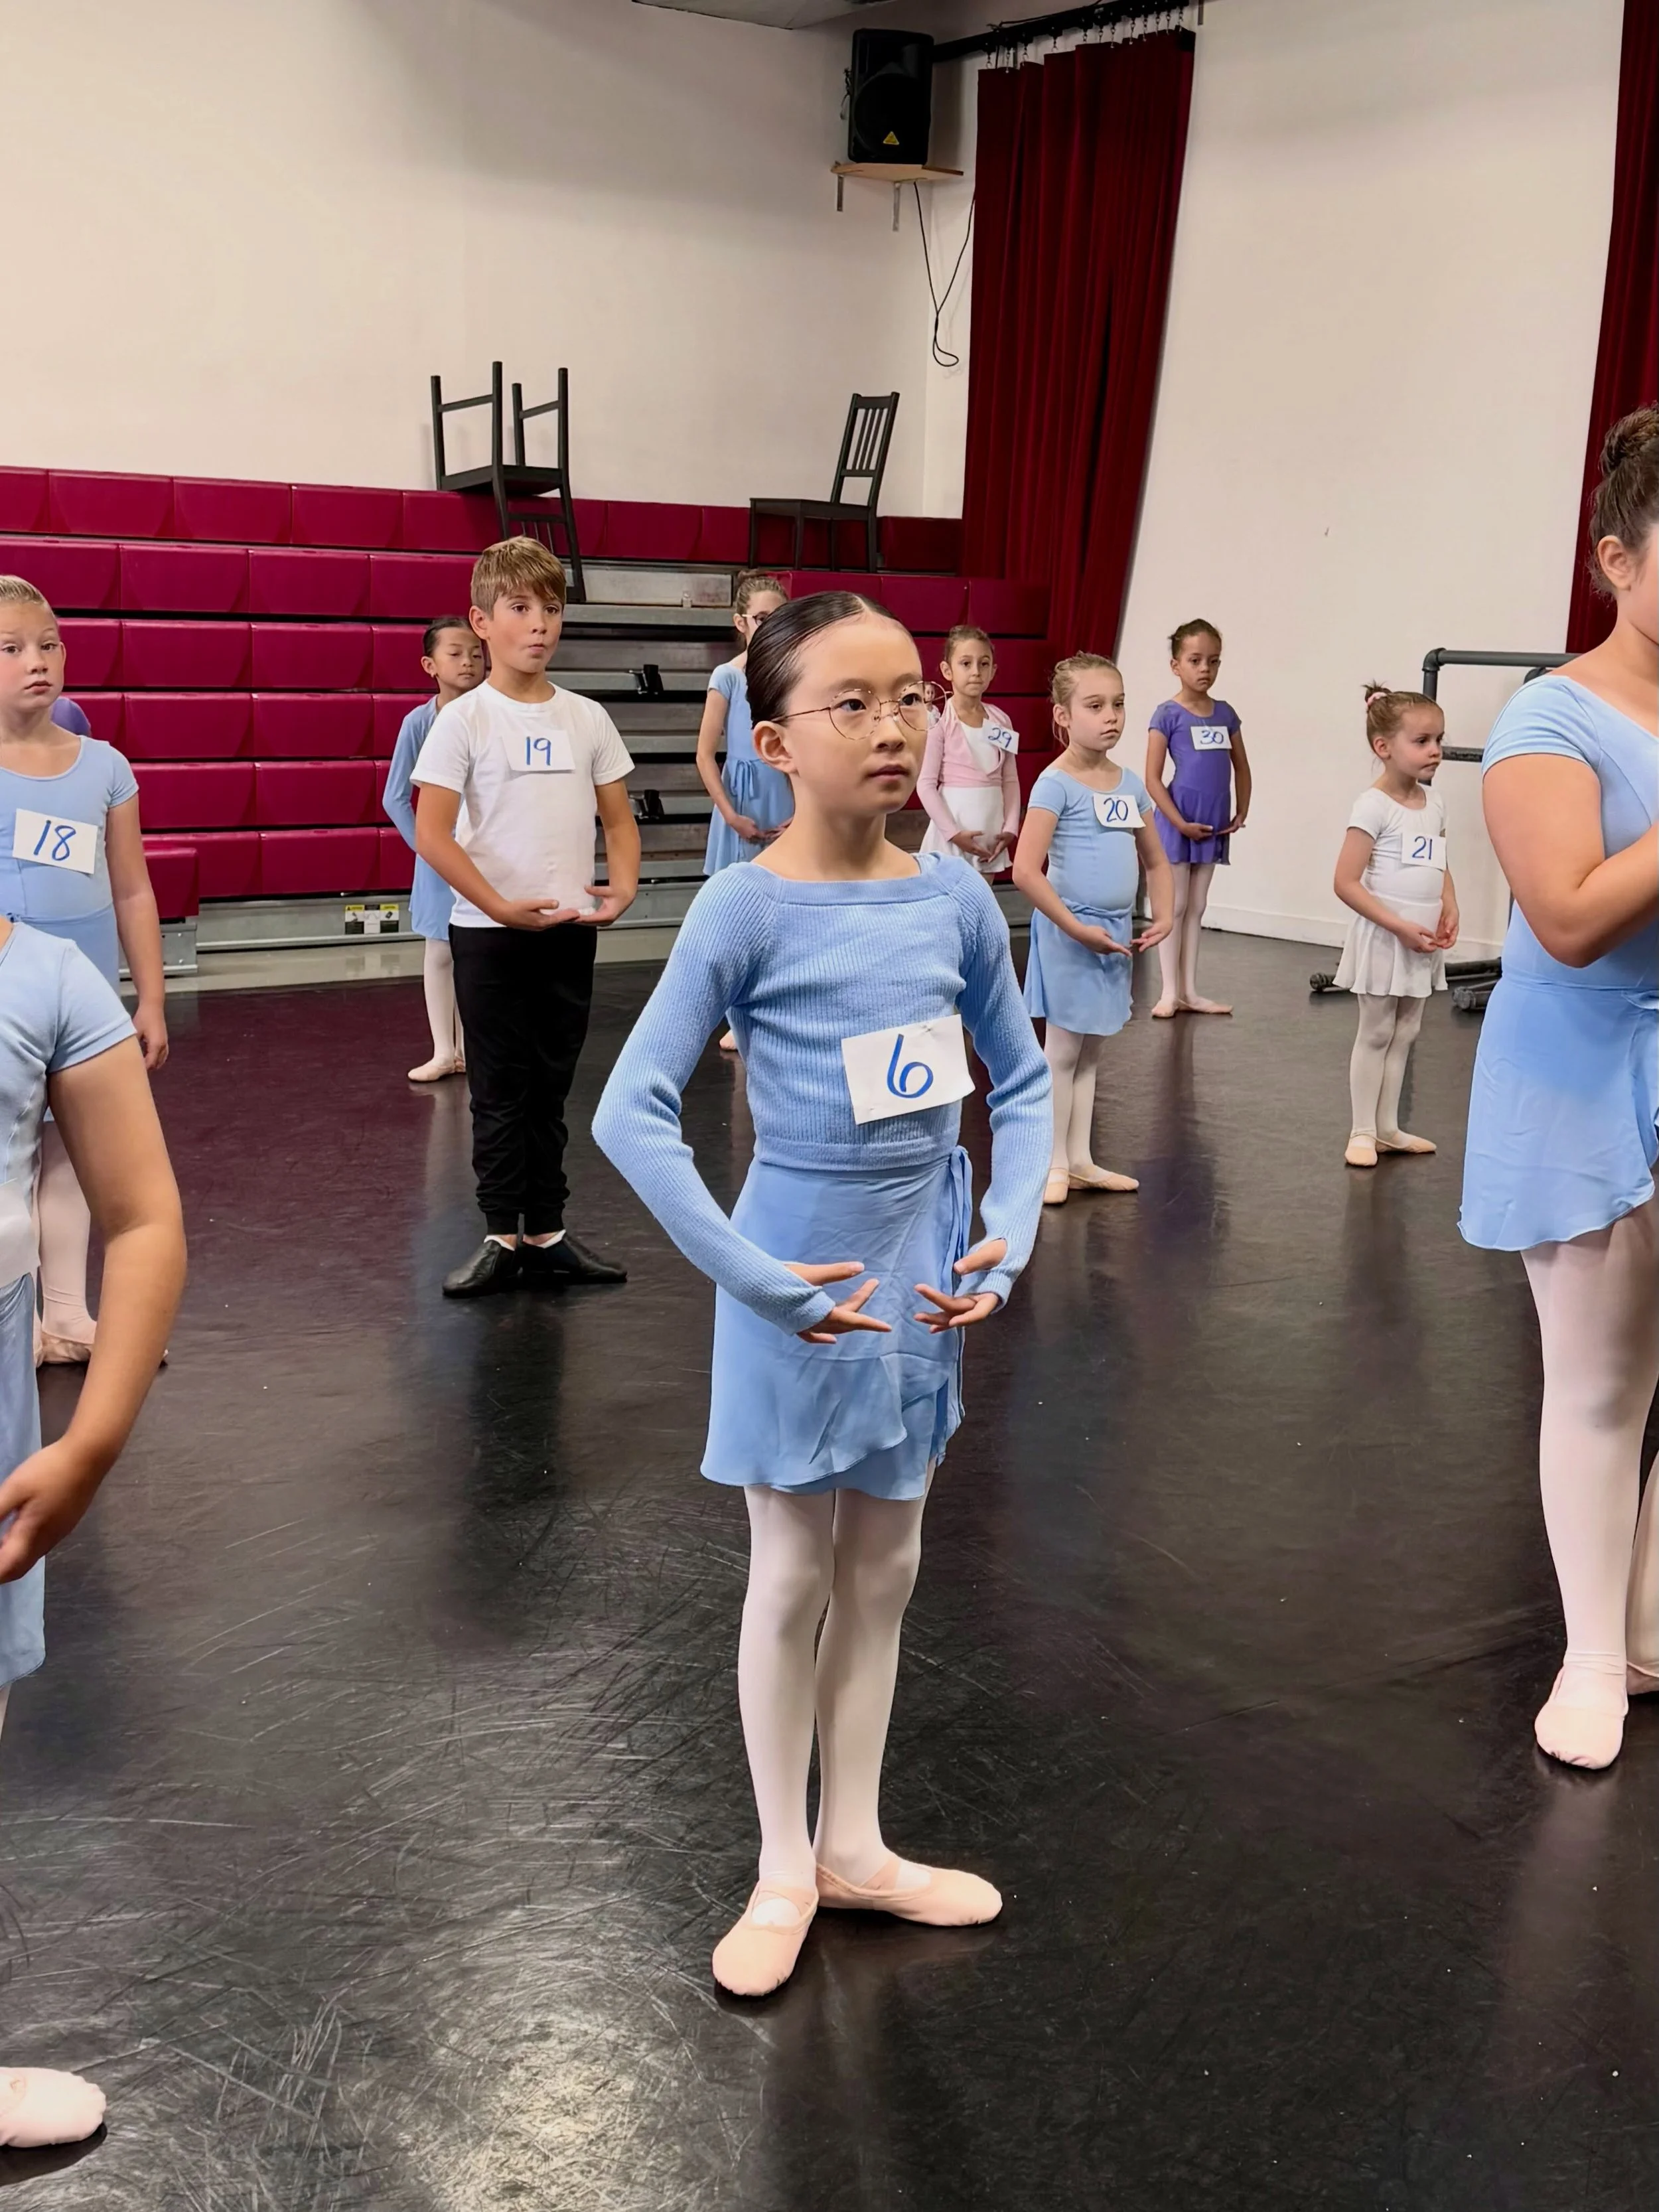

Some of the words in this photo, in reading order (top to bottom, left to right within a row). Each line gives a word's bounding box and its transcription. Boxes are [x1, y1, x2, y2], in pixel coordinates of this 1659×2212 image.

[987, 727, 1012, 749] 29
[1200, 730, 1224, 744] 30
[526, 736, 551, 766] 19
[1104, 798, 1129, 822] 20
[34, 820, 76, 861] 18
[1412, 836, 1433, 860] 21
[887, 1033, 934, 1098] 6
